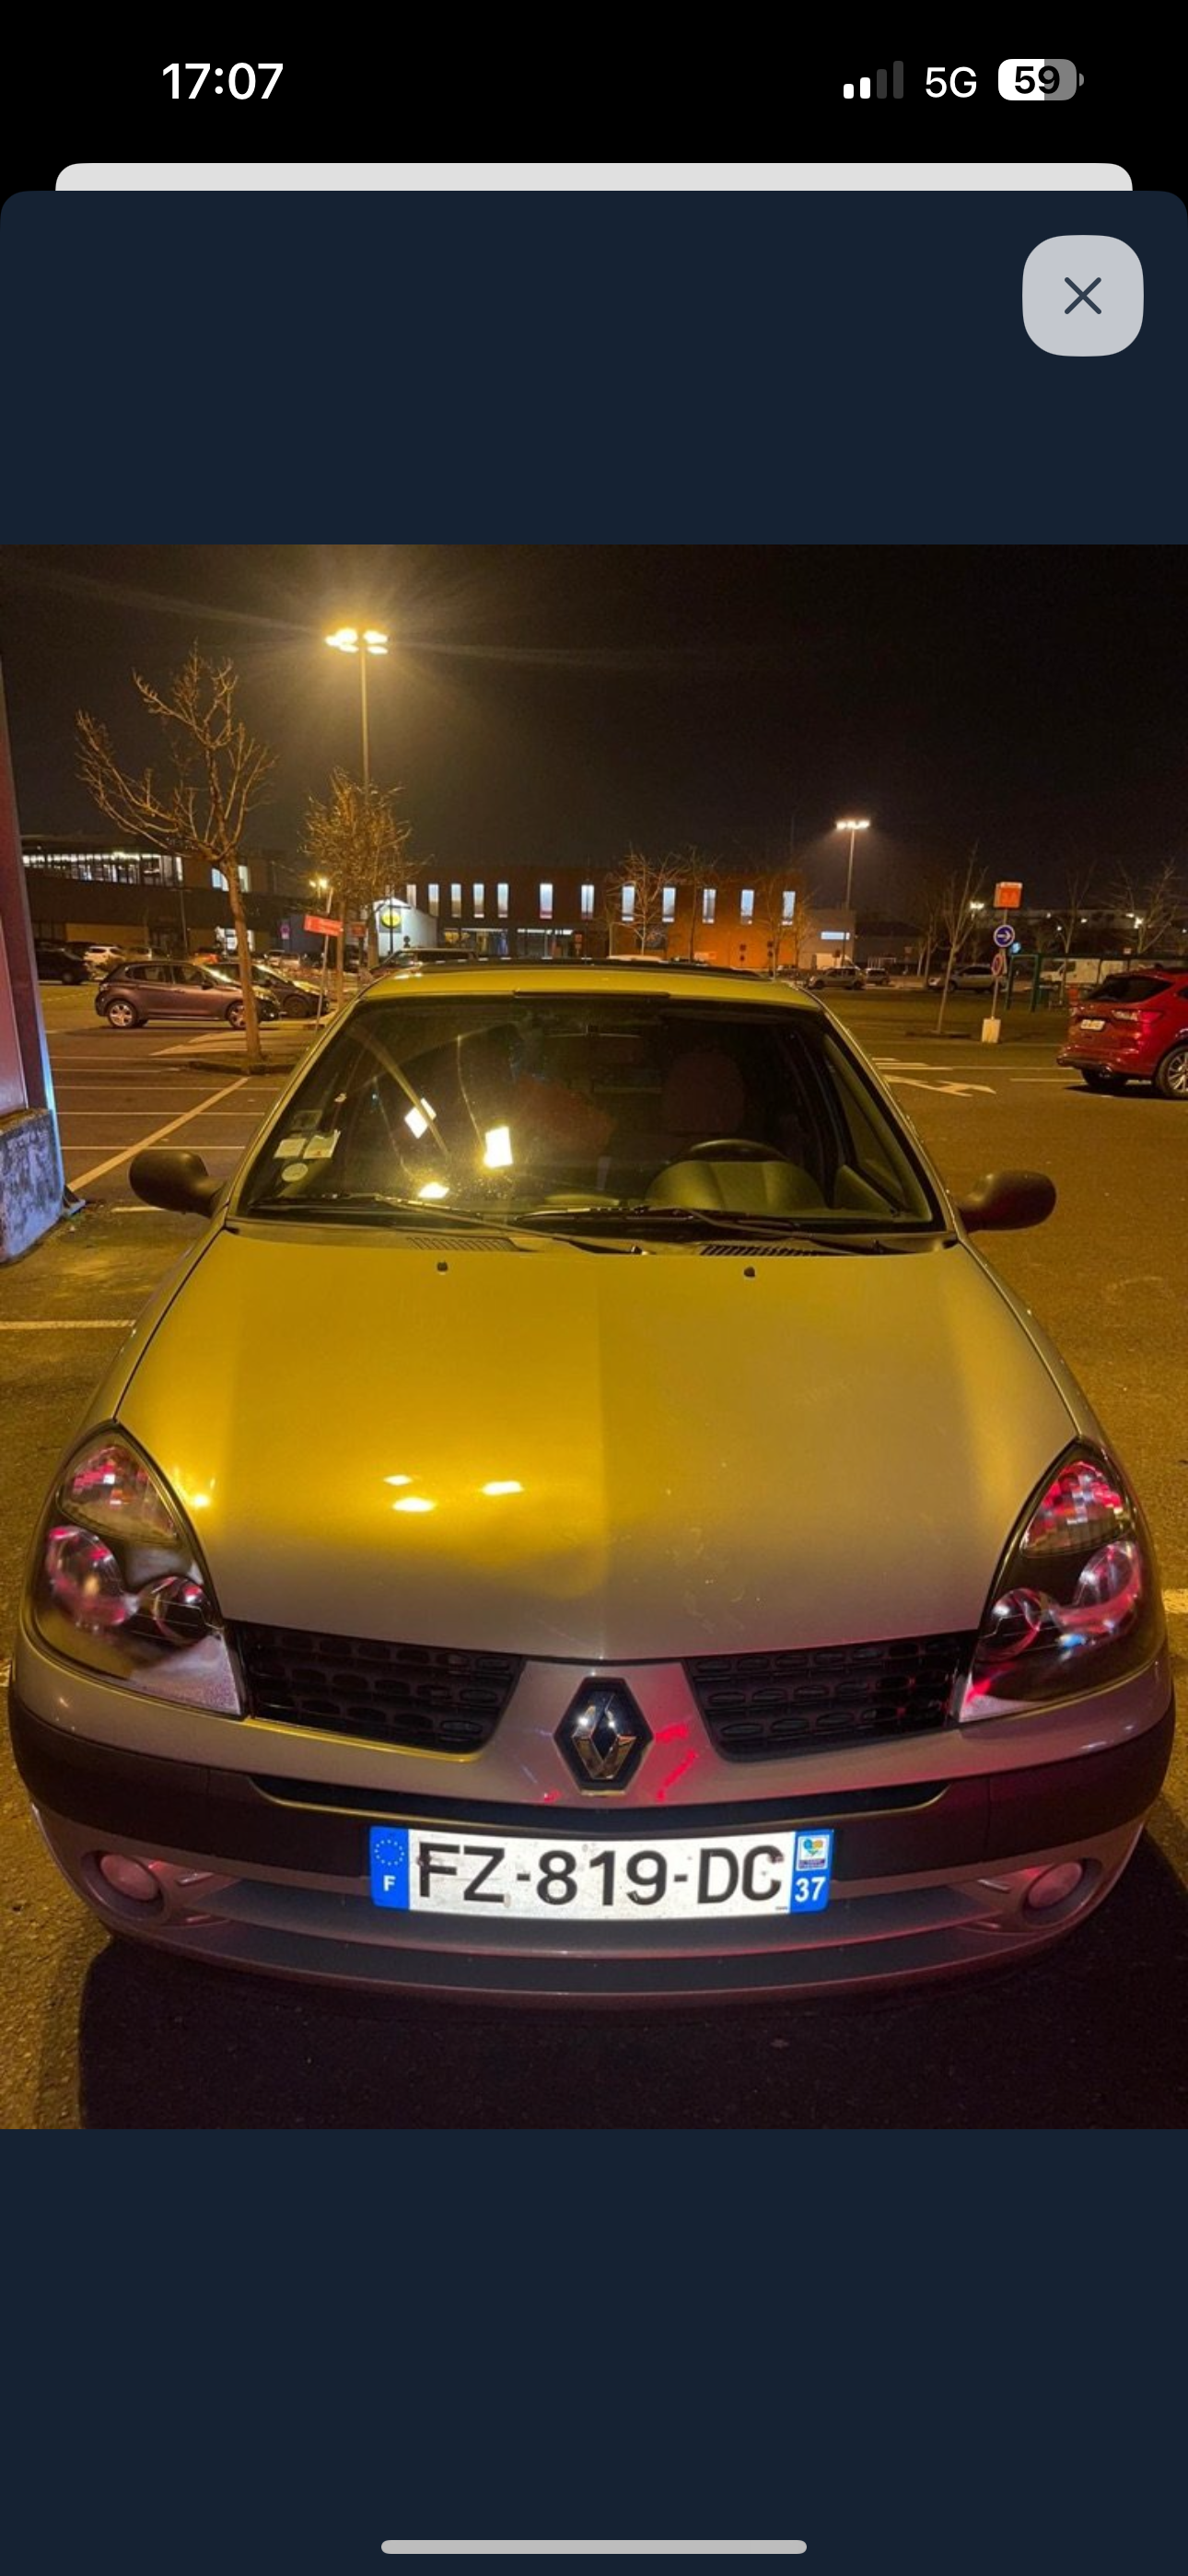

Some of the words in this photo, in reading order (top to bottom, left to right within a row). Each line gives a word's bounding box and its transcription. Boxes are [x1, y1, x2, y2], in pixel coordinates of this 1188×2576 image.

[382, 1874, 396, 1892] F
[417, 1842, 783, 1905] FZ-819-DC
[794, 1876, 826, 1903] 37
